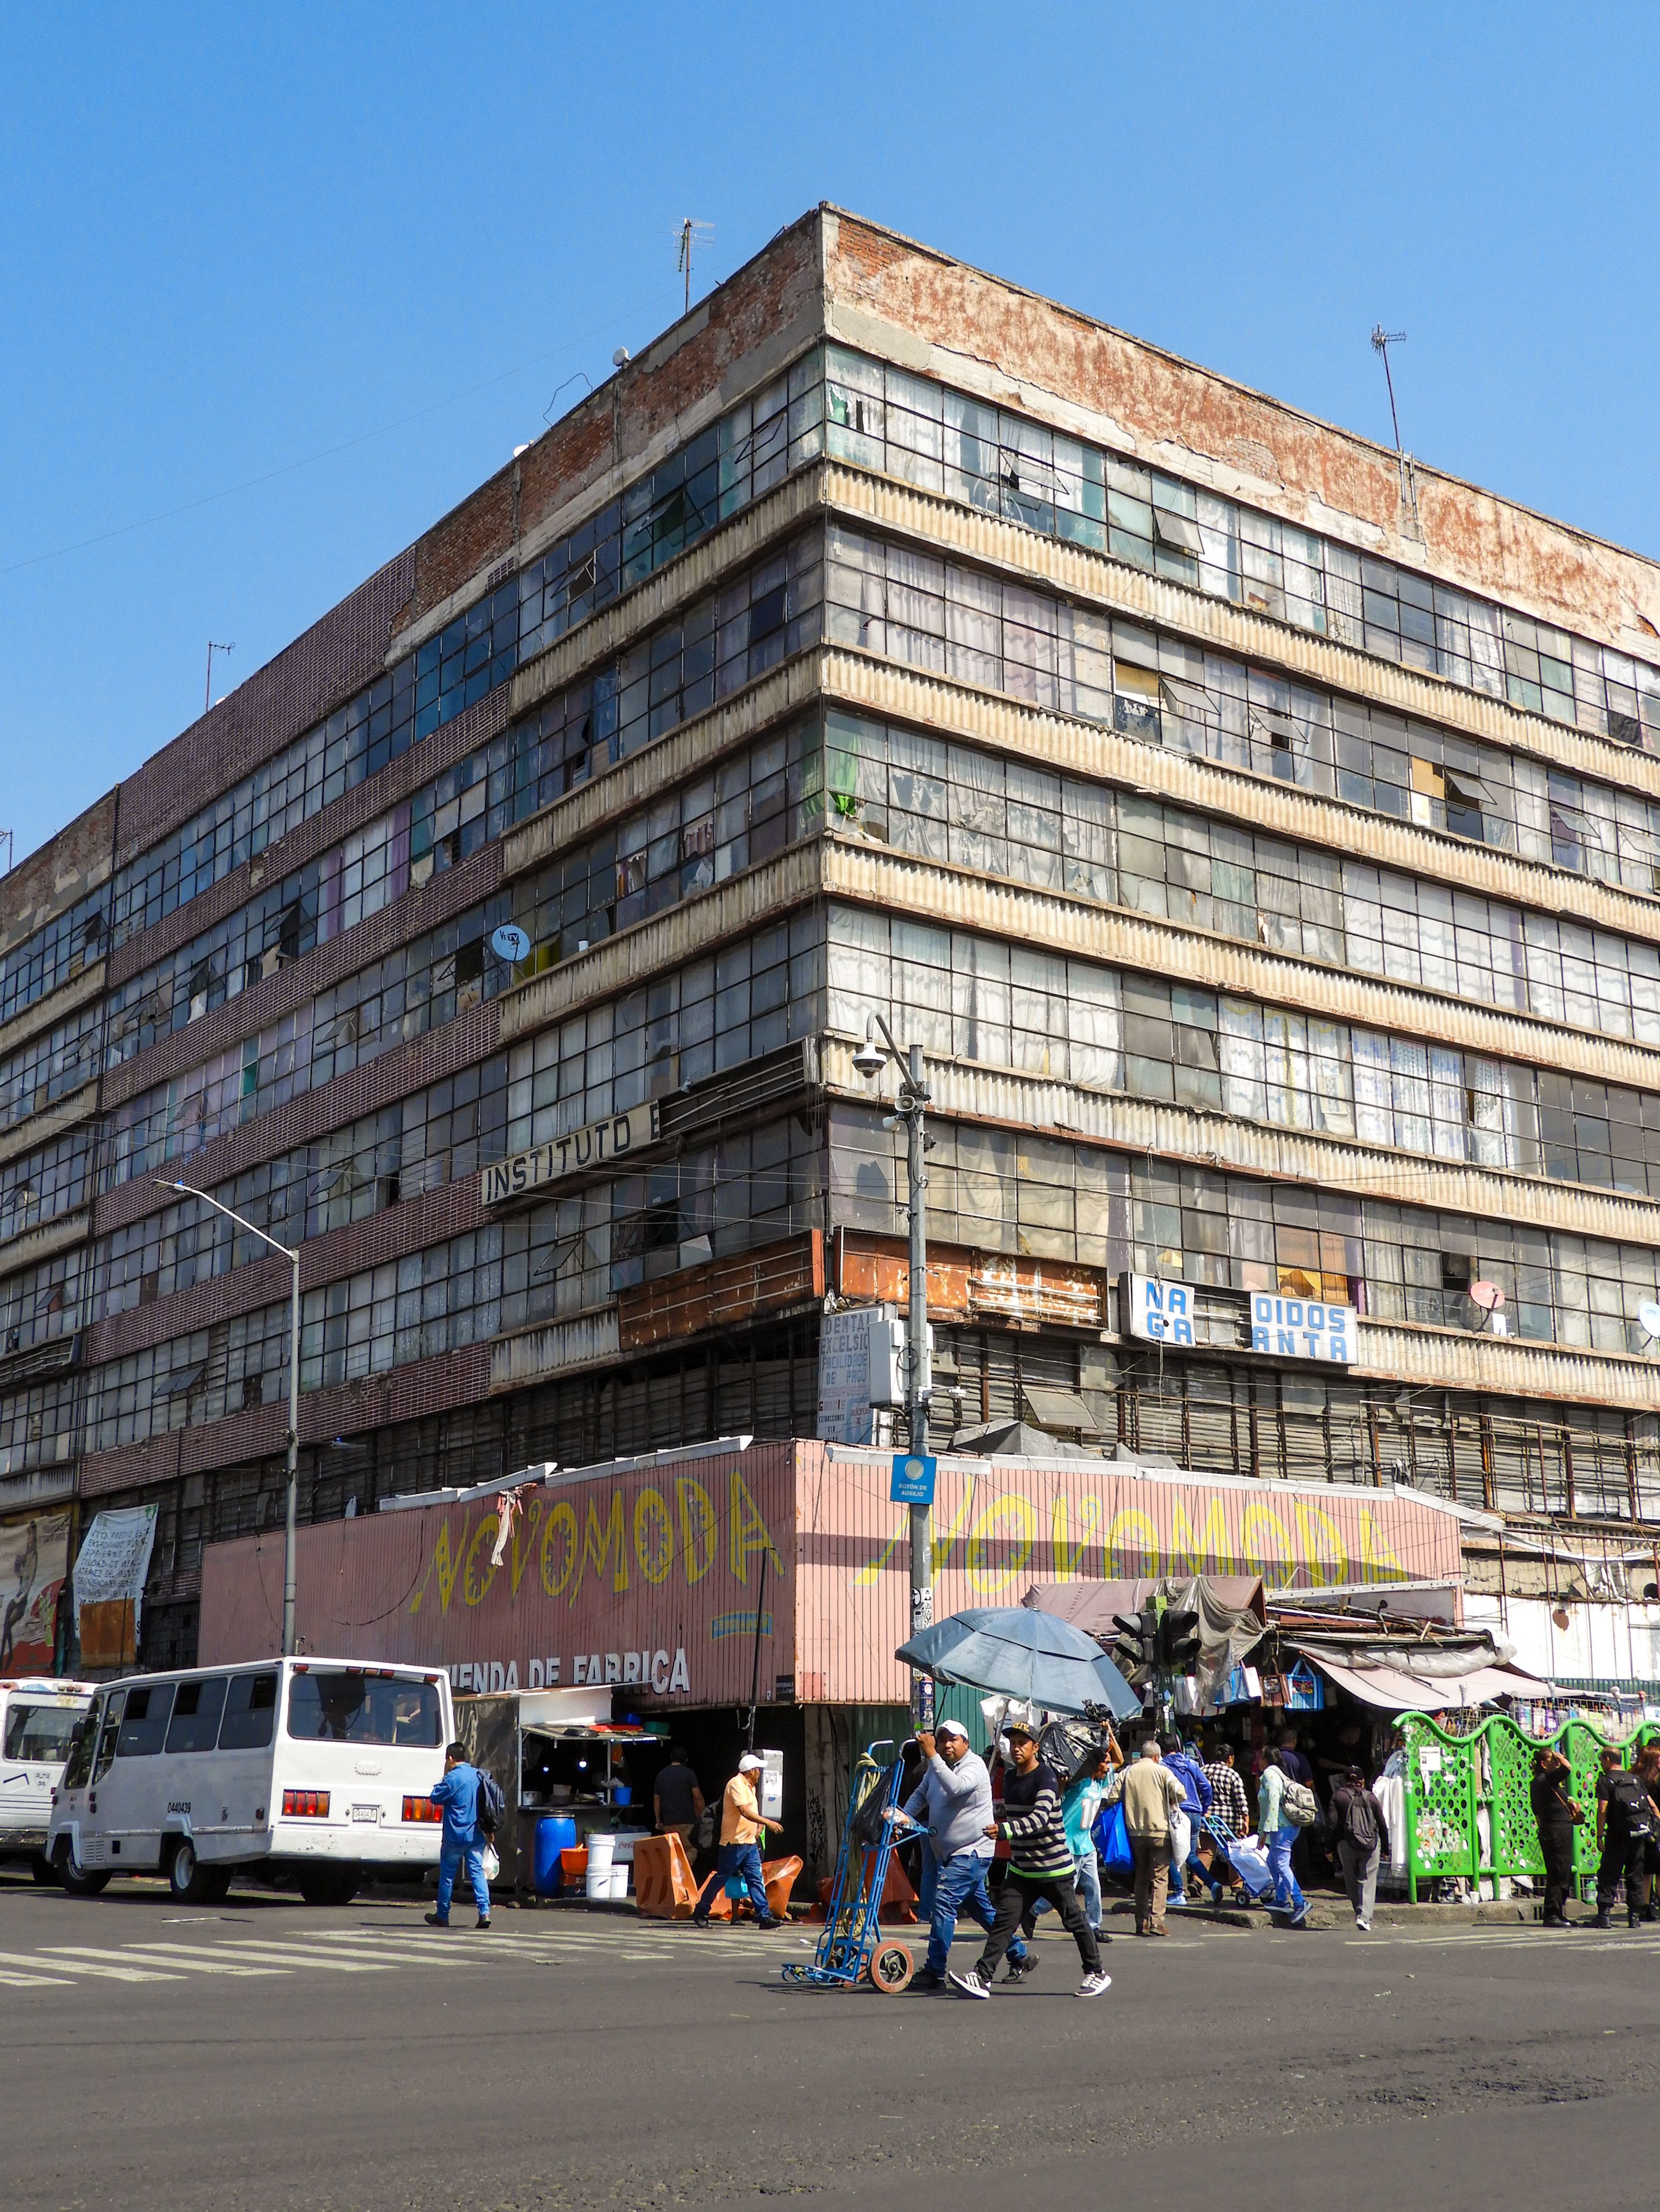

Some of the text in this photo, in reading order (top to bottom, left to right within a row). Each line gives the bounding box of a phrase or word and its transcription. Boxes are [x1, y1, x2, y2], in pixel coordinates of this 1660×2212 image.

[487, 1104, 660, 1202] INSTITUTO E
[1146, 1281, 1186, 1315] NA
[1147, 1312, 1192, 1344] GA
[1256, 1297, 1345, 1334] OIDOS
[1253, 1327, 1347, 1361] ANTA
[826, 1372, 836, 1385] DE
[819, 1414, 844, 1423] EXTRACCIONES
[409, 1471, 785, 1612] NOVOMODA
[529, 1657, 561, 1688] DE
[573, 1647, 690, 1695] FABRICA
[167, 1802, 191, 1813] 0440439
